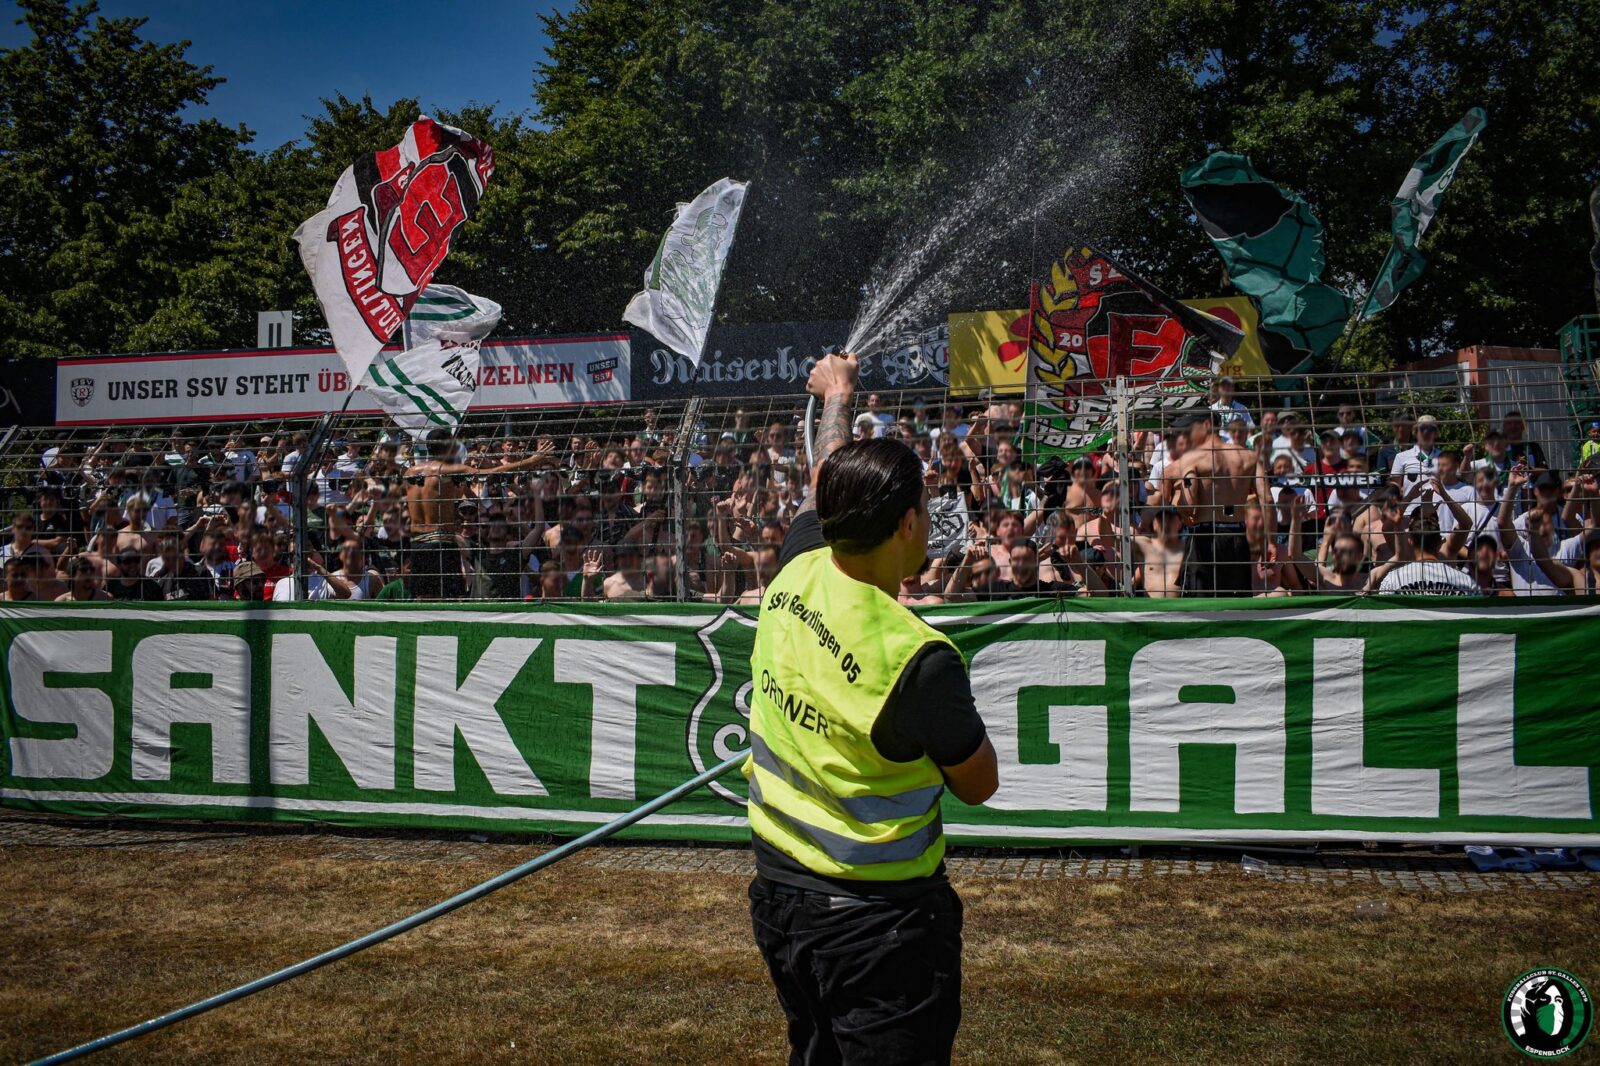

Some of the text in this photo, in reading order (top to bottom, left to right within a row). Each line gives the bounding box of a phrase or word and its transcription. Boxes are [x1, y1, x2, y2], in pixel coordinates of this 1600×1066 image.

[108, 379, 178, 400] UNSER
[187, 377, 228, 397] SSV
[236, 373, 310, 395] STEHT
[589, 359, 616, 372] UNSER
[594, 371, 610, 382] SSV
[768, 590, 861, 684] SSV Reutlingen 05
[8, 629, 1593, 820] SANKT GALL
[761, 669, 829, 739] ORDNER
